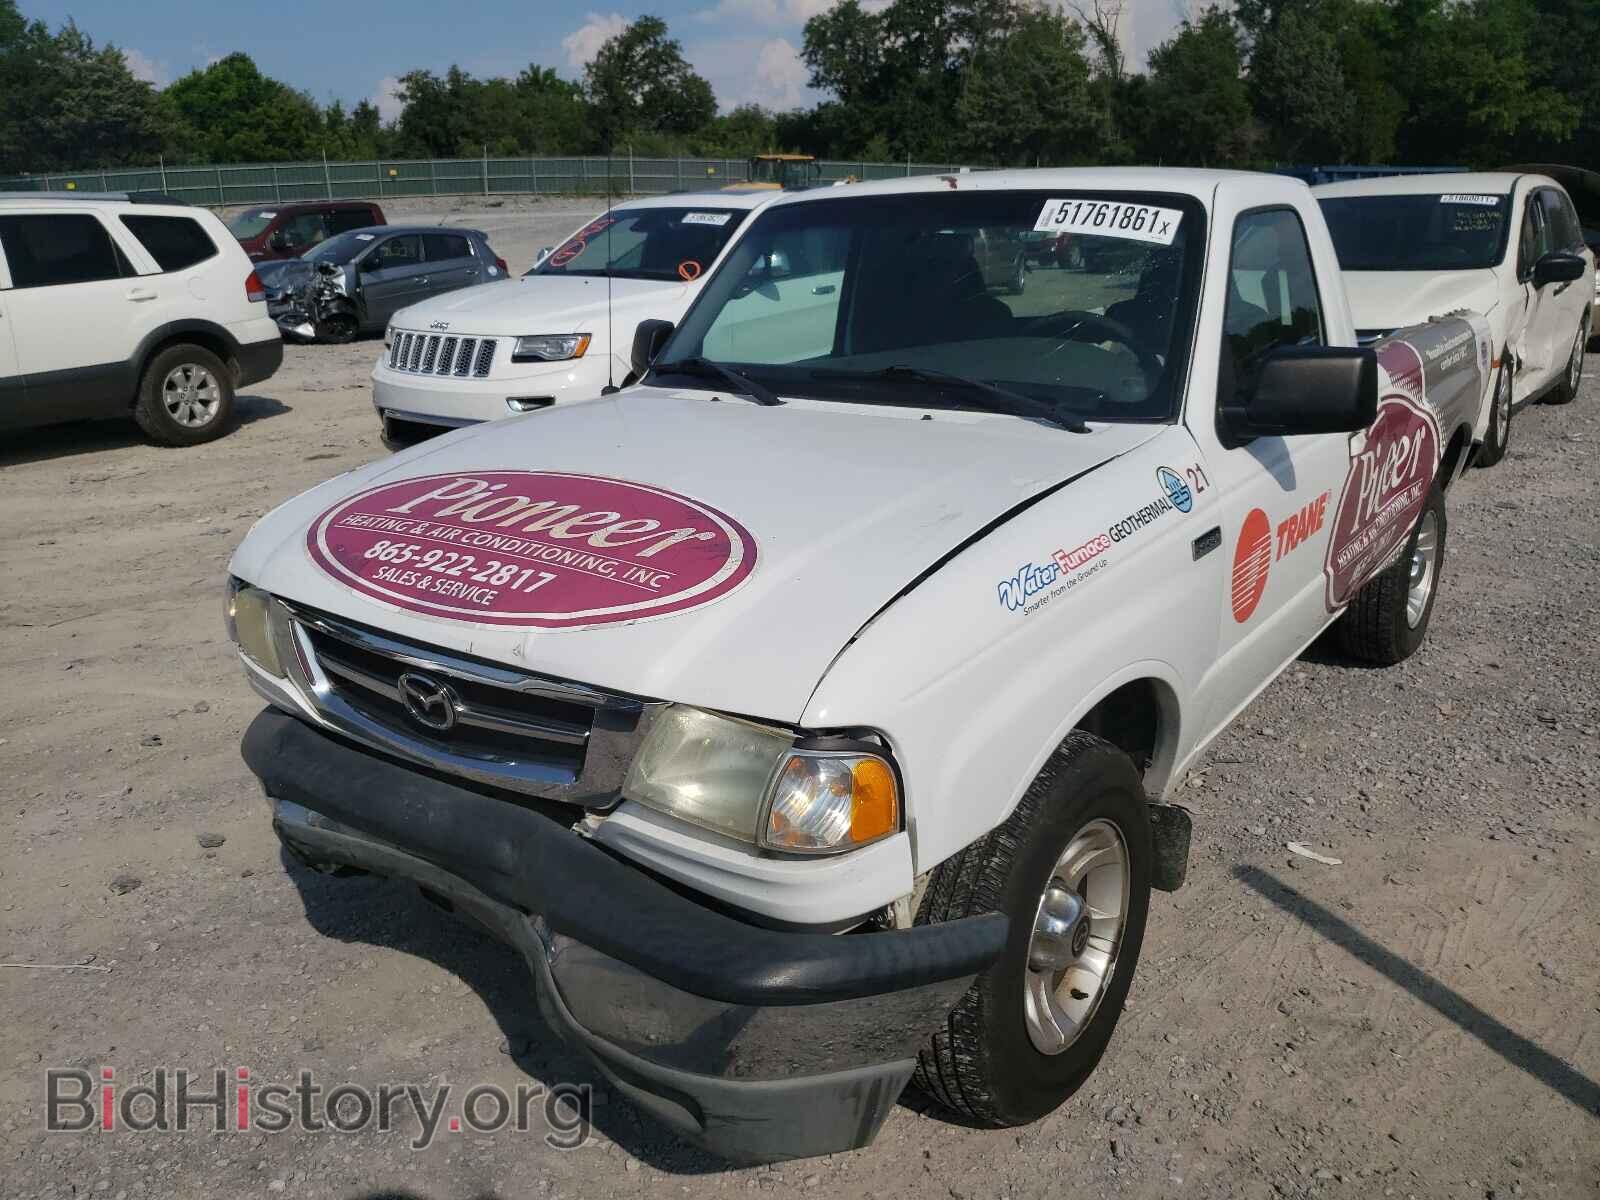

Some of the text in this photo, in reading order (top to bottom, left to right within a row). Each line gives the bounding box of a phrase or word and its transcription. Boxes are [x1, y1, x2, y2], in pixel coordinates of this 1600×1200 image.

[1055, 202, 1160, 233] 51761861
[1186, 463, 1210, 494] 21
[387, 478, 716, 558] Pioneer
[1109, 497, 1173, 543] GEOTHERMAL
[1276, 491, 1328, 562] TRANE
[342, 513, 671, 589] HEATING & AIR CONDITIONING, INC
[364, 540, 558, 593] 865-922-2817
[372, 565, 498, 606] SALES & SERVICE
[1024, 594, 1050, 616] Smarter
[1050, 584, 1066, 600] from
[1066, 577, 1077, 590] the
